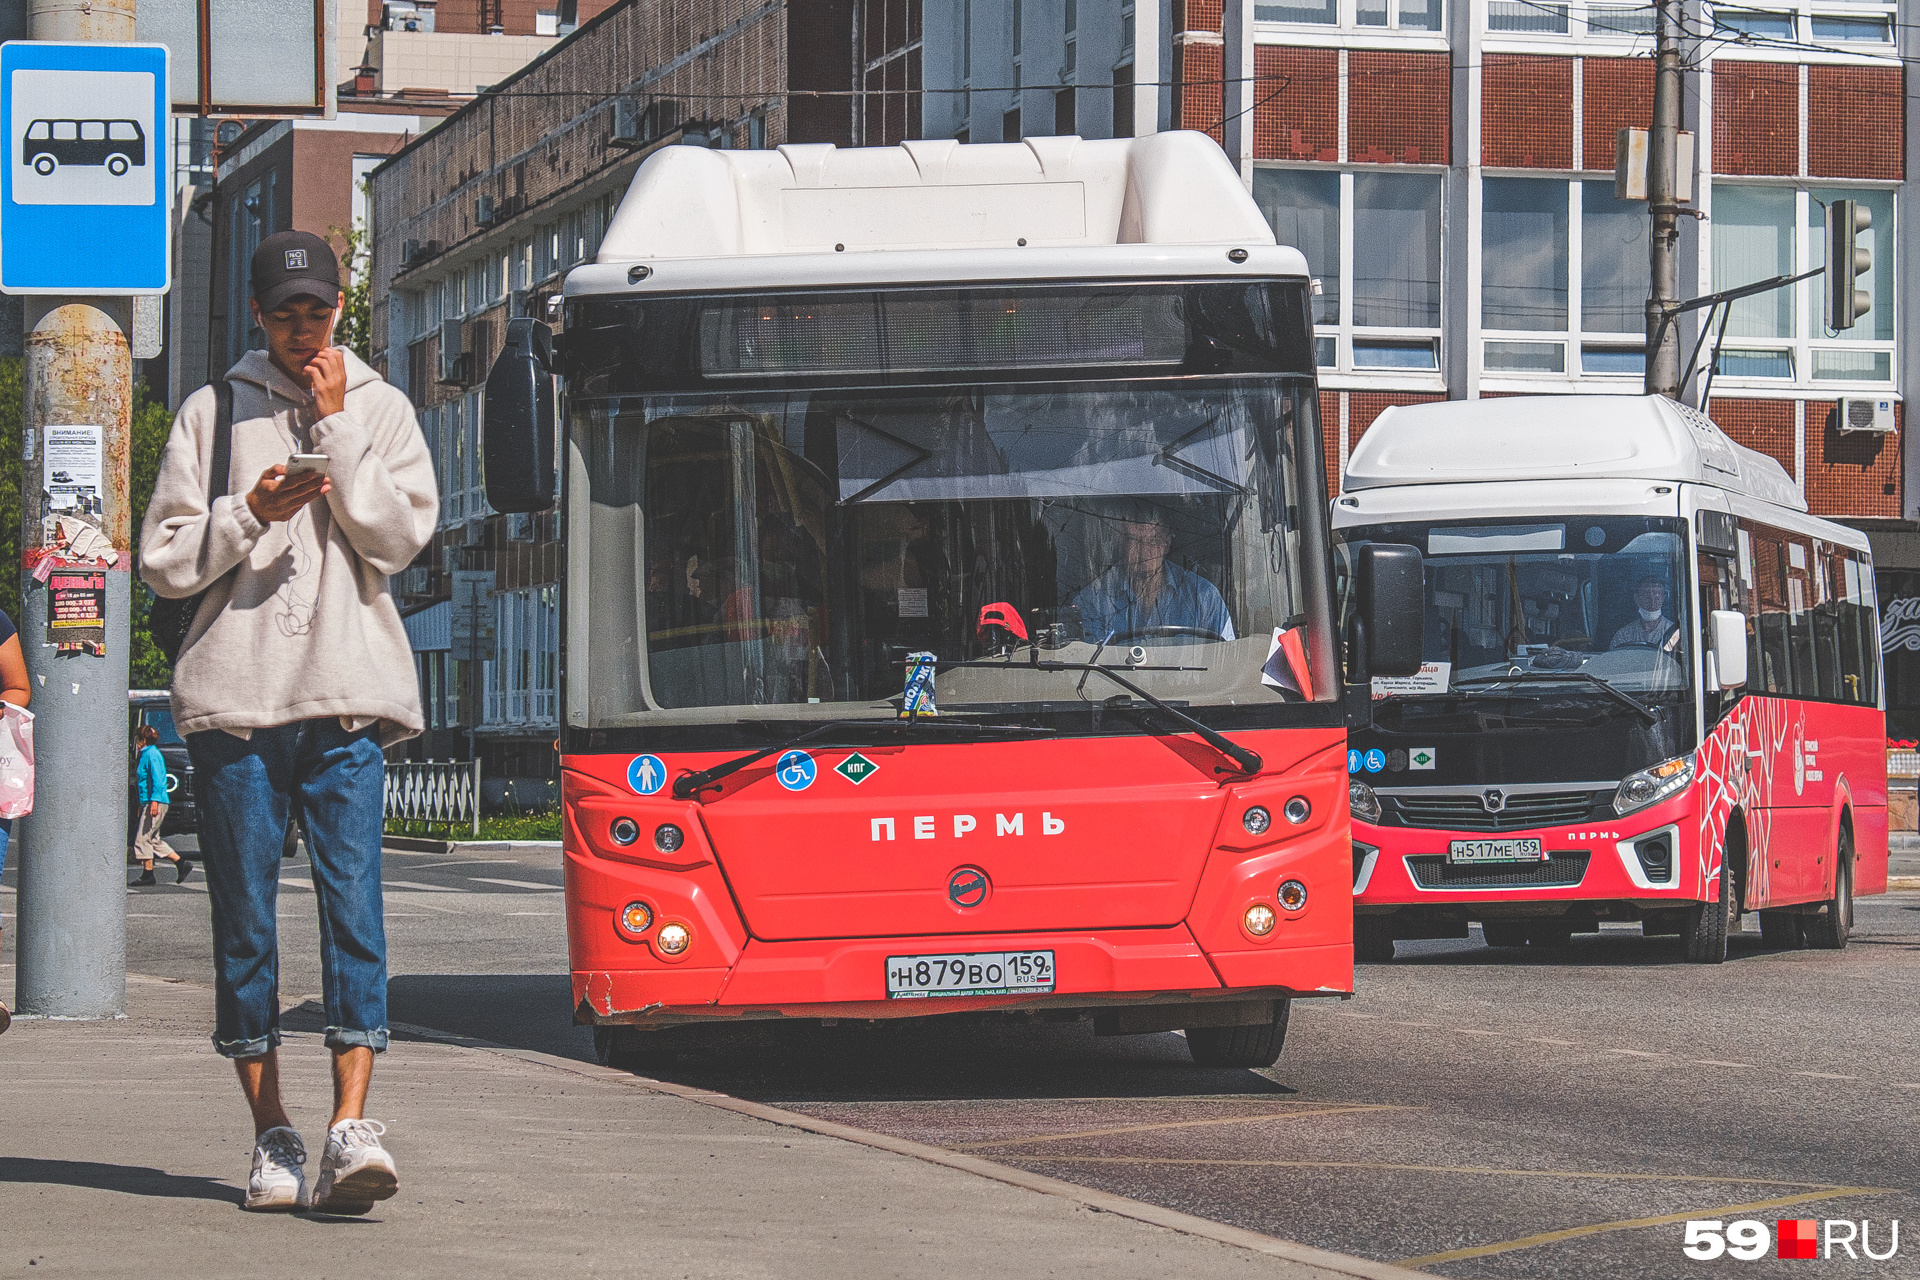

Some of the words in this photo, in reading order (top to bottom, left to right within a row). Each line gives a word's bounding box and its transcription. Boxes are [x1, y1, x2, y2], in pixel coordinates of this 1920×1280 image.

[50, 576, 104, 590] ДЕНЬГИ
[847, 763, 866, 774] КПГ
[871, 812, 1065, 841] ПЕРМЬ
[1568, 831, 1620, 840] ПЕРМЬ
[1515, 841, 1537, 853] 159
[1007, 955, 1046, 976] 159
[1016, 975, 1036, 983] RUS
